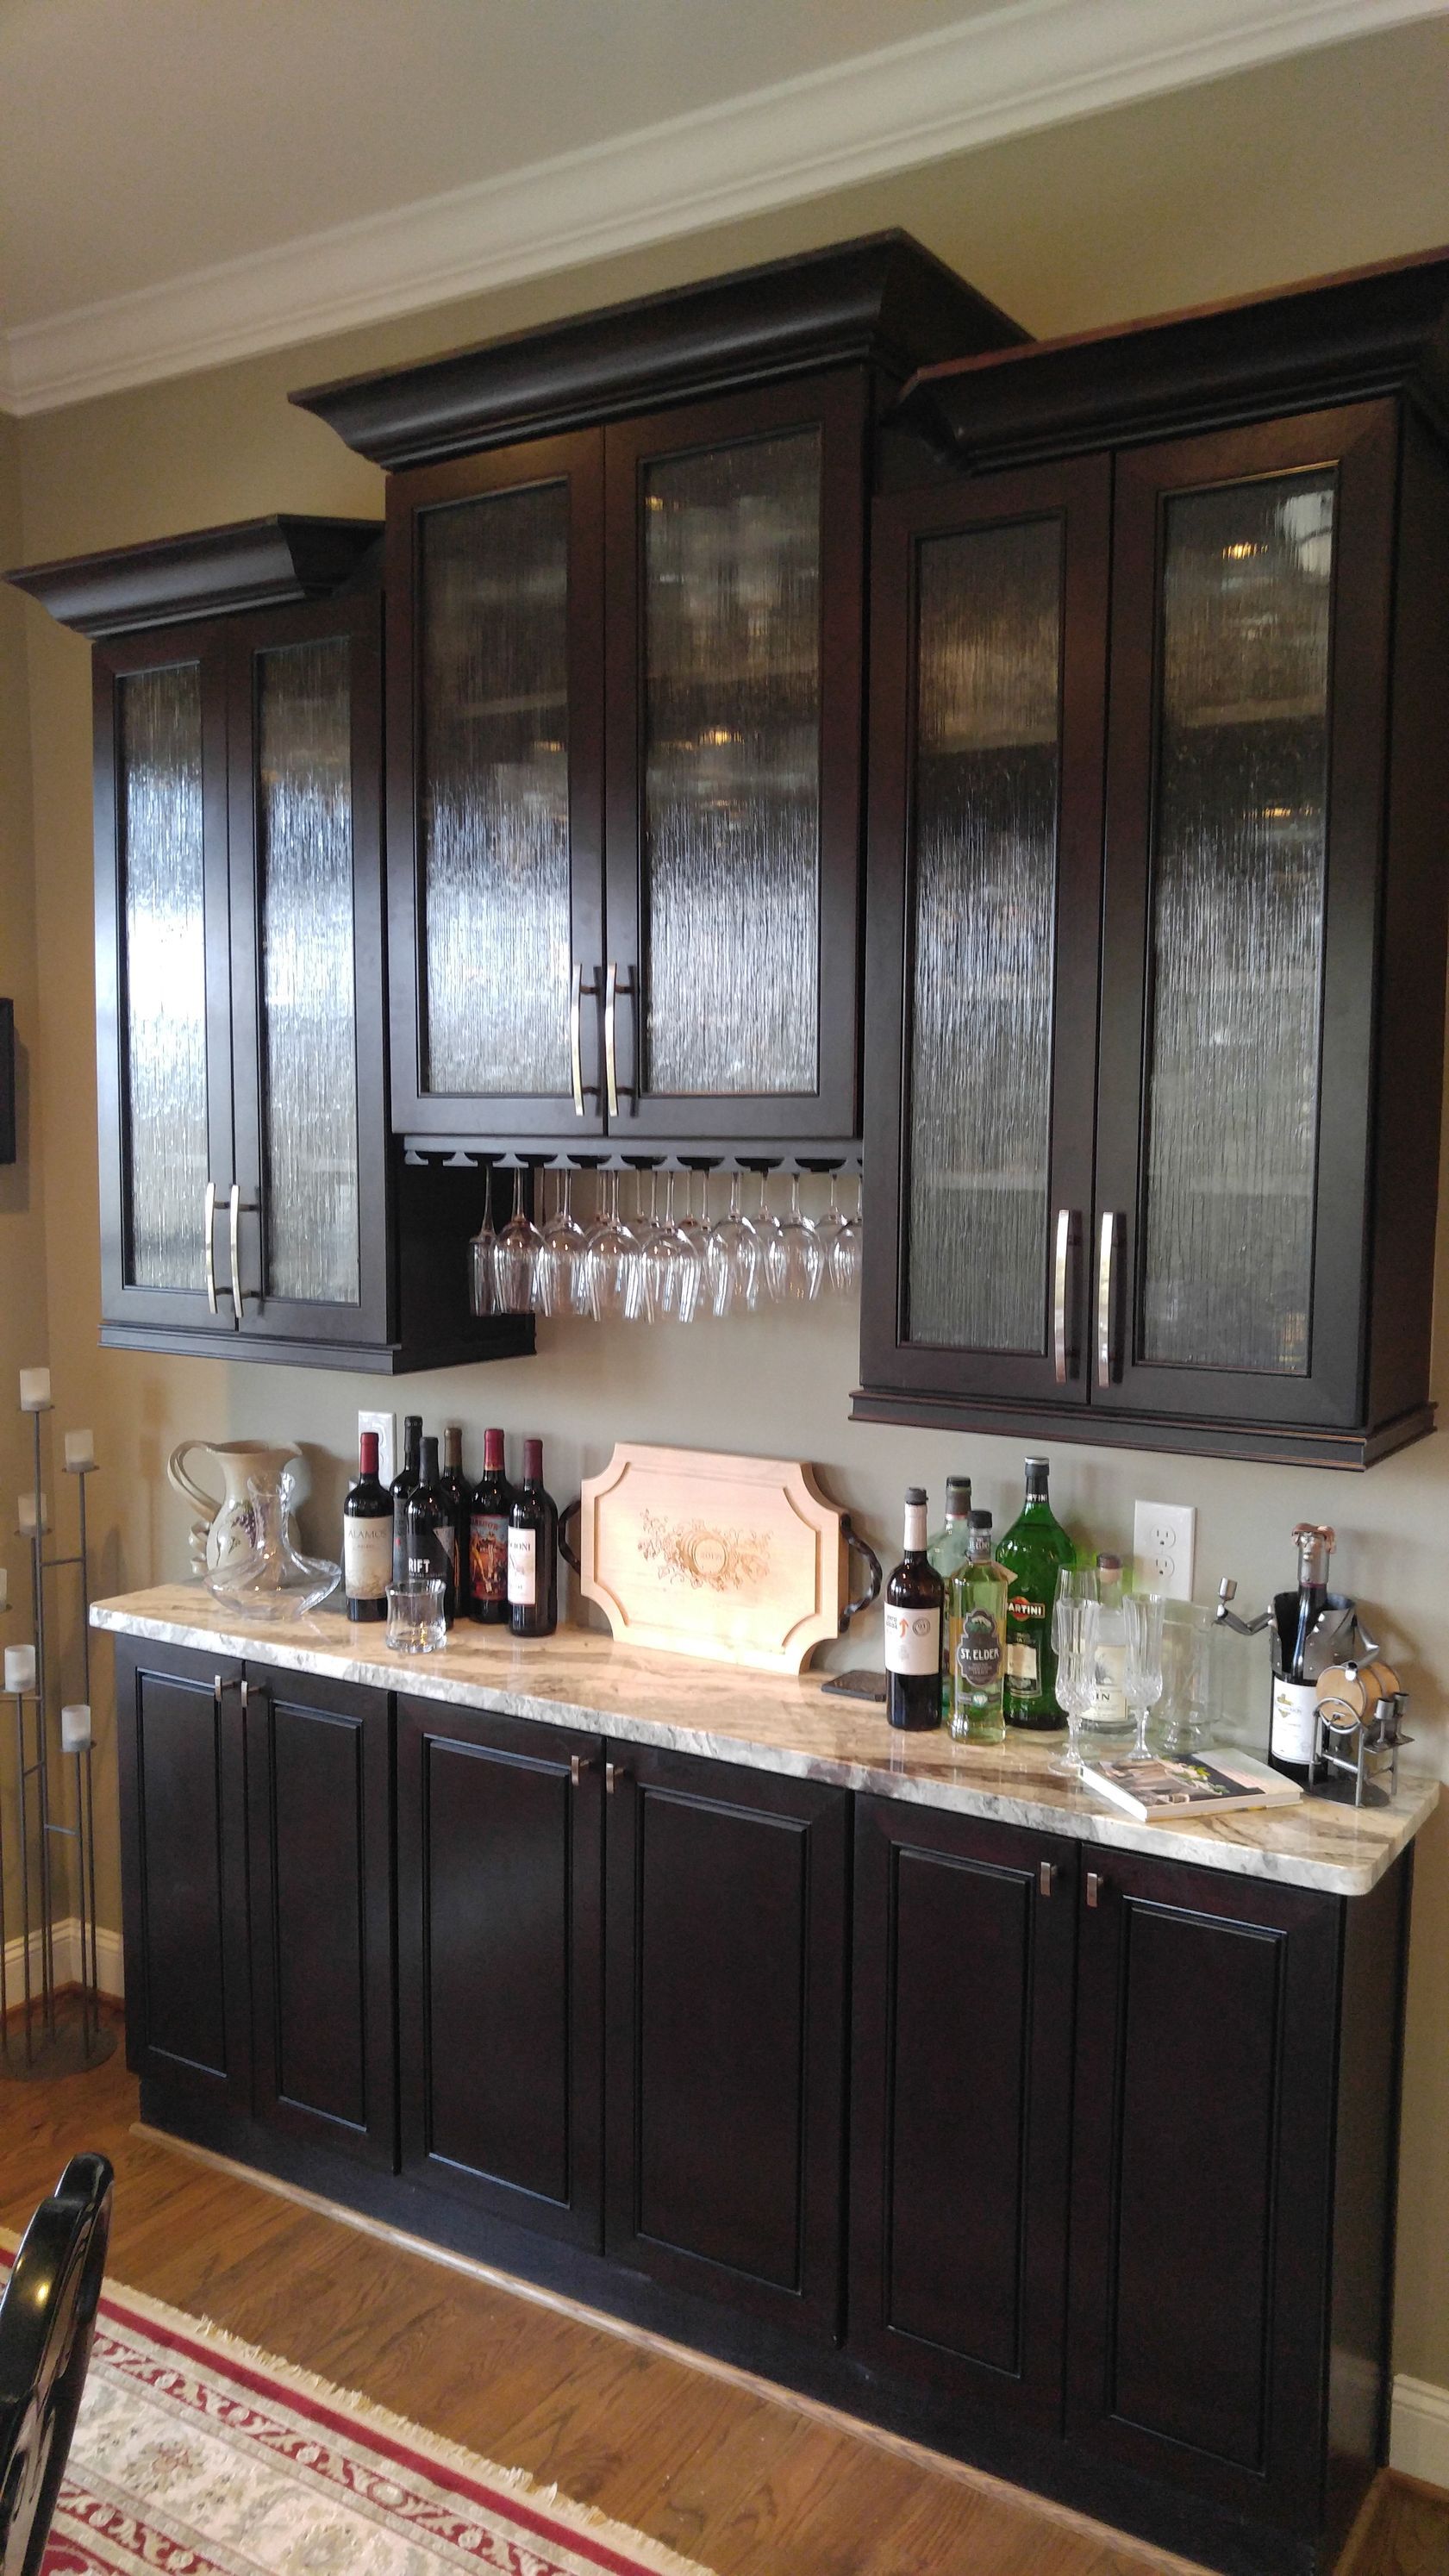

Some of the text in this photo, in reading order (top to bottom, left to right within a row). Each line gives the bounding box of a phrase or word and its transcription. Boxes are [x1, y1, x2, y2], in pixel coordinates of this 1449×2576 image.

[347, 1529, 387, 1539] ALAMOS
[1007, 1603, 1042, 1616] ARTINI
[960, 1648, 1000, 1661] ST. ELDER
